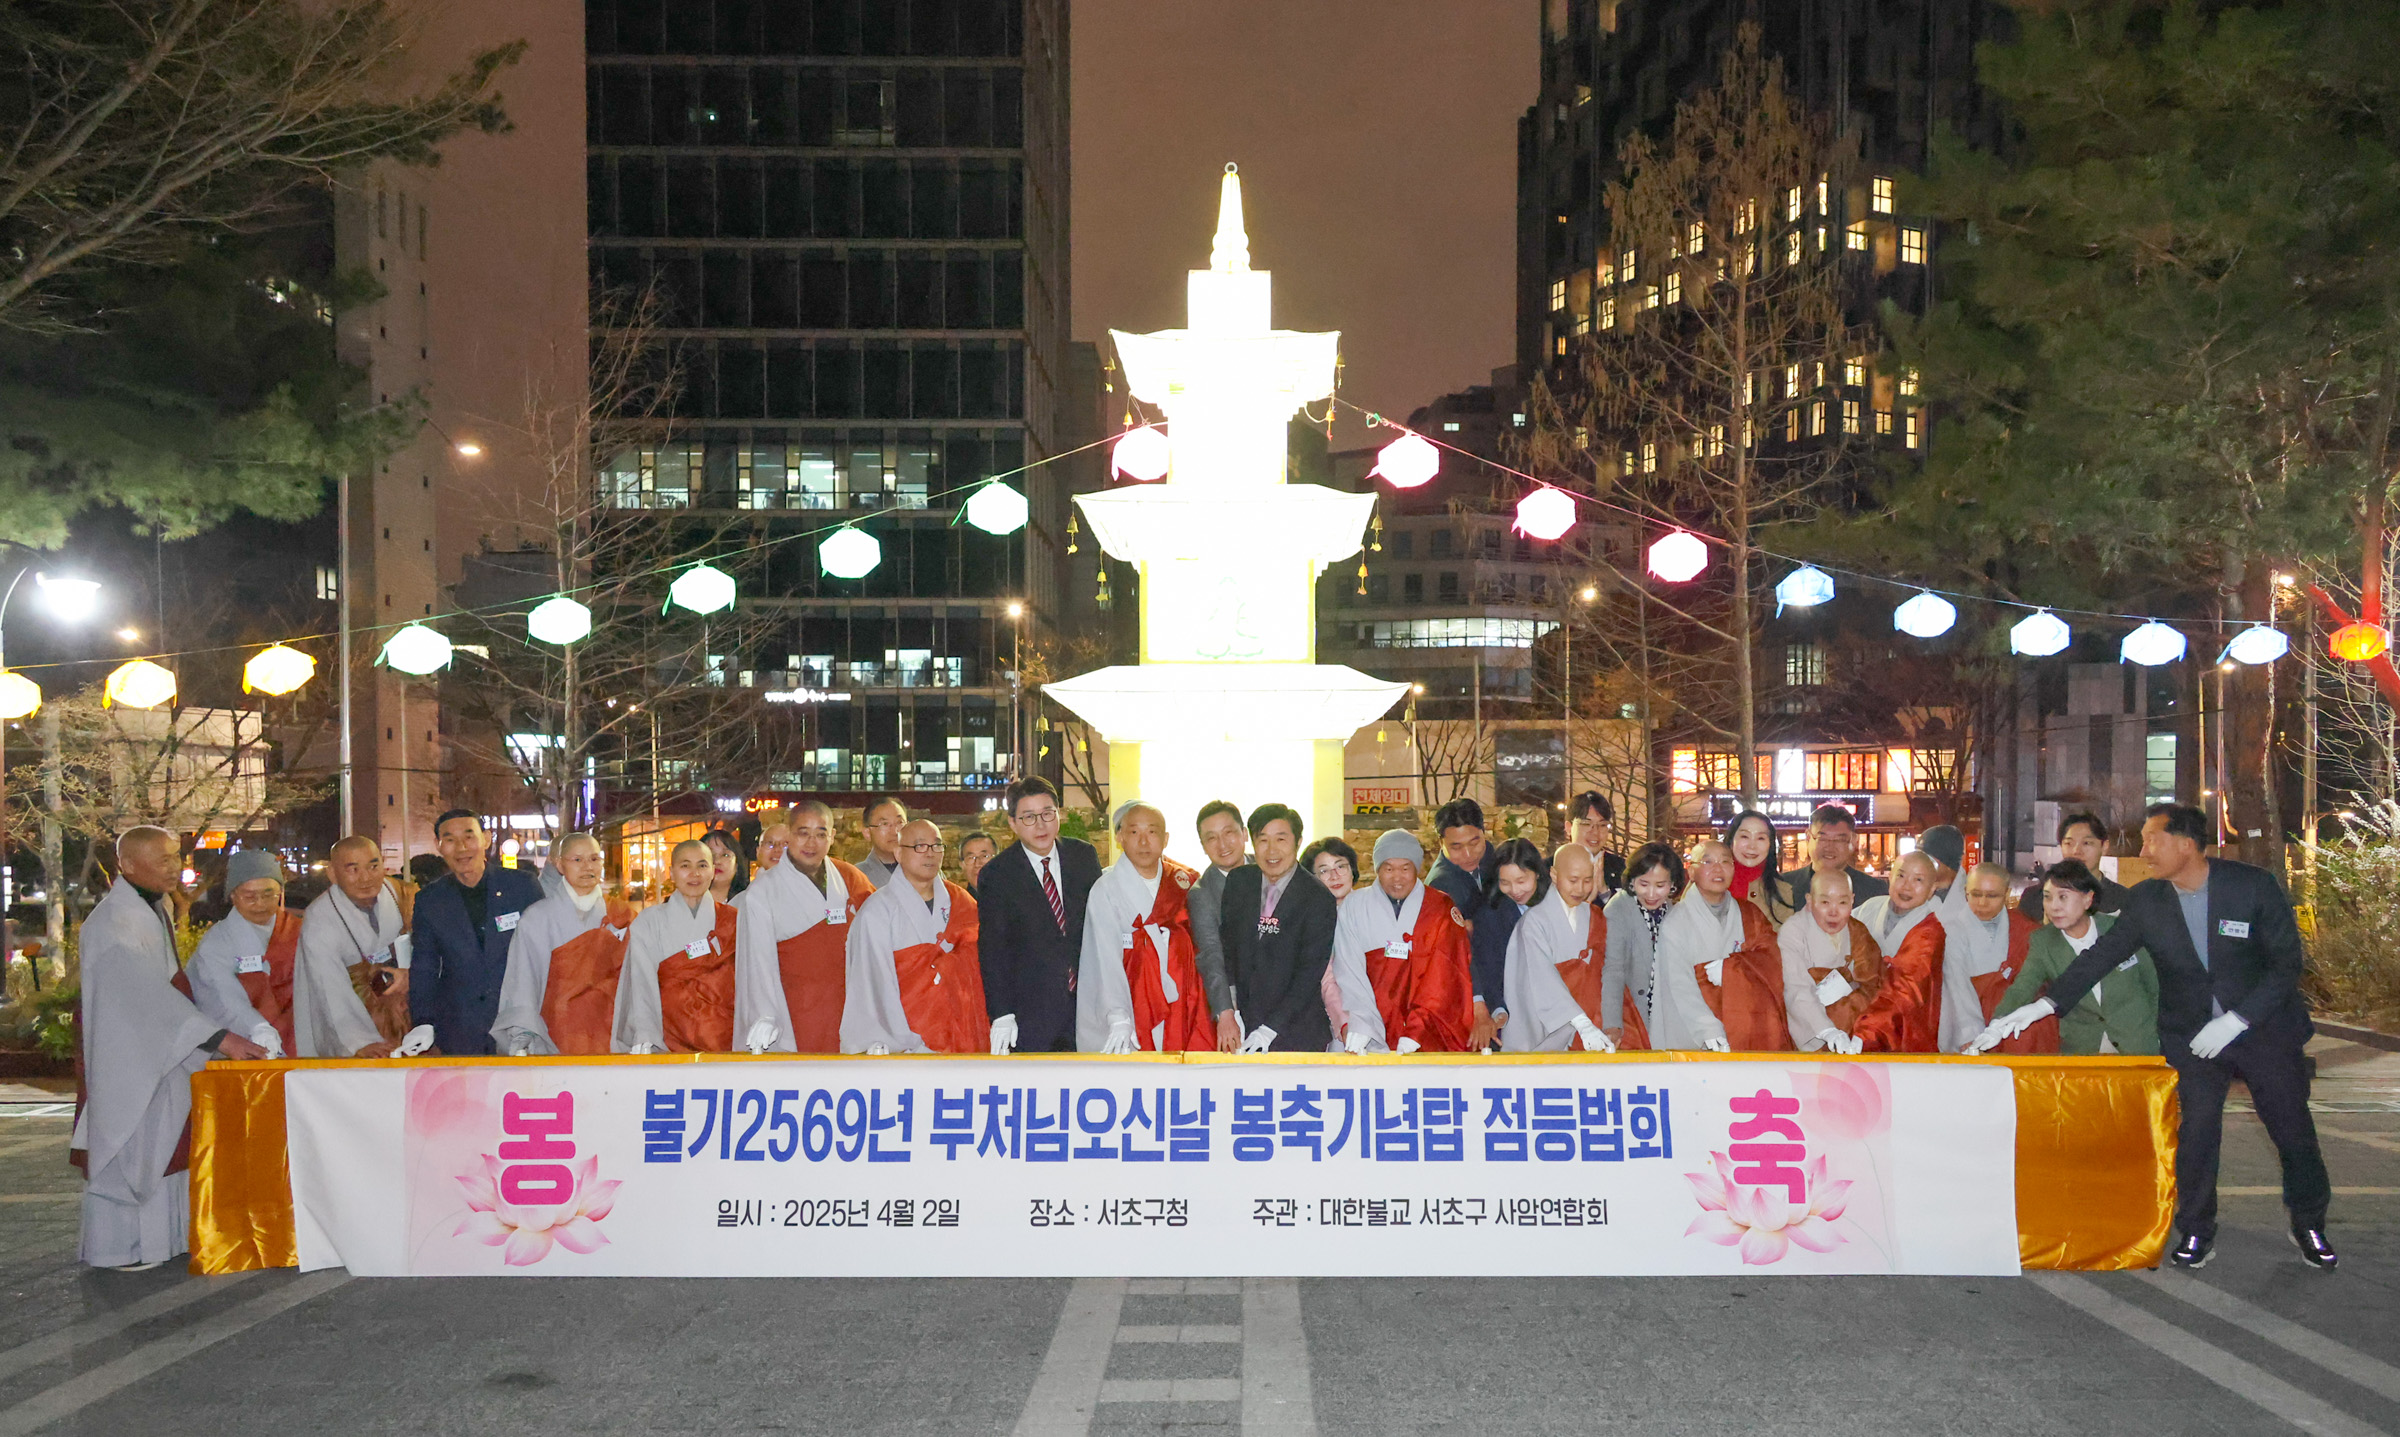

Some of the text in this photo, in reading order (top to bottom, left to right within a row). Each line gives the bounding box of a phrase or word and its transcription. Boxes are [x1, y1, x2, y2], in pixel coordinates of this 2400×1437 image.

[1354, 789, 1408, 804] 전체임대
[642, 1084, 1673, 1163] 불기2569년 부처님오신날 봉축기념탑 점등법회
[497, 1090, 577, 1207] 봉
[1728, 1088, 1807, 1205] 축
[717, 1199, 763, 1228] 일시
[783, 1199, 869, 1227] 2025년
[876, 1199, 915, 1227] 4월
[922, 1199, 960, 1227] 2일
[1030, 1199, 1076, 1227] 장소
[1097, 1198, 1188, 1227] 서초구청
[1253, 1198, 1298, 1227] 주관
[1320, 1198, 1412, 1227] 대한불교
[1419, 1198, 1487, 1226] 서초구
[1495, 1197, 1608, 1226] 사암연합회
